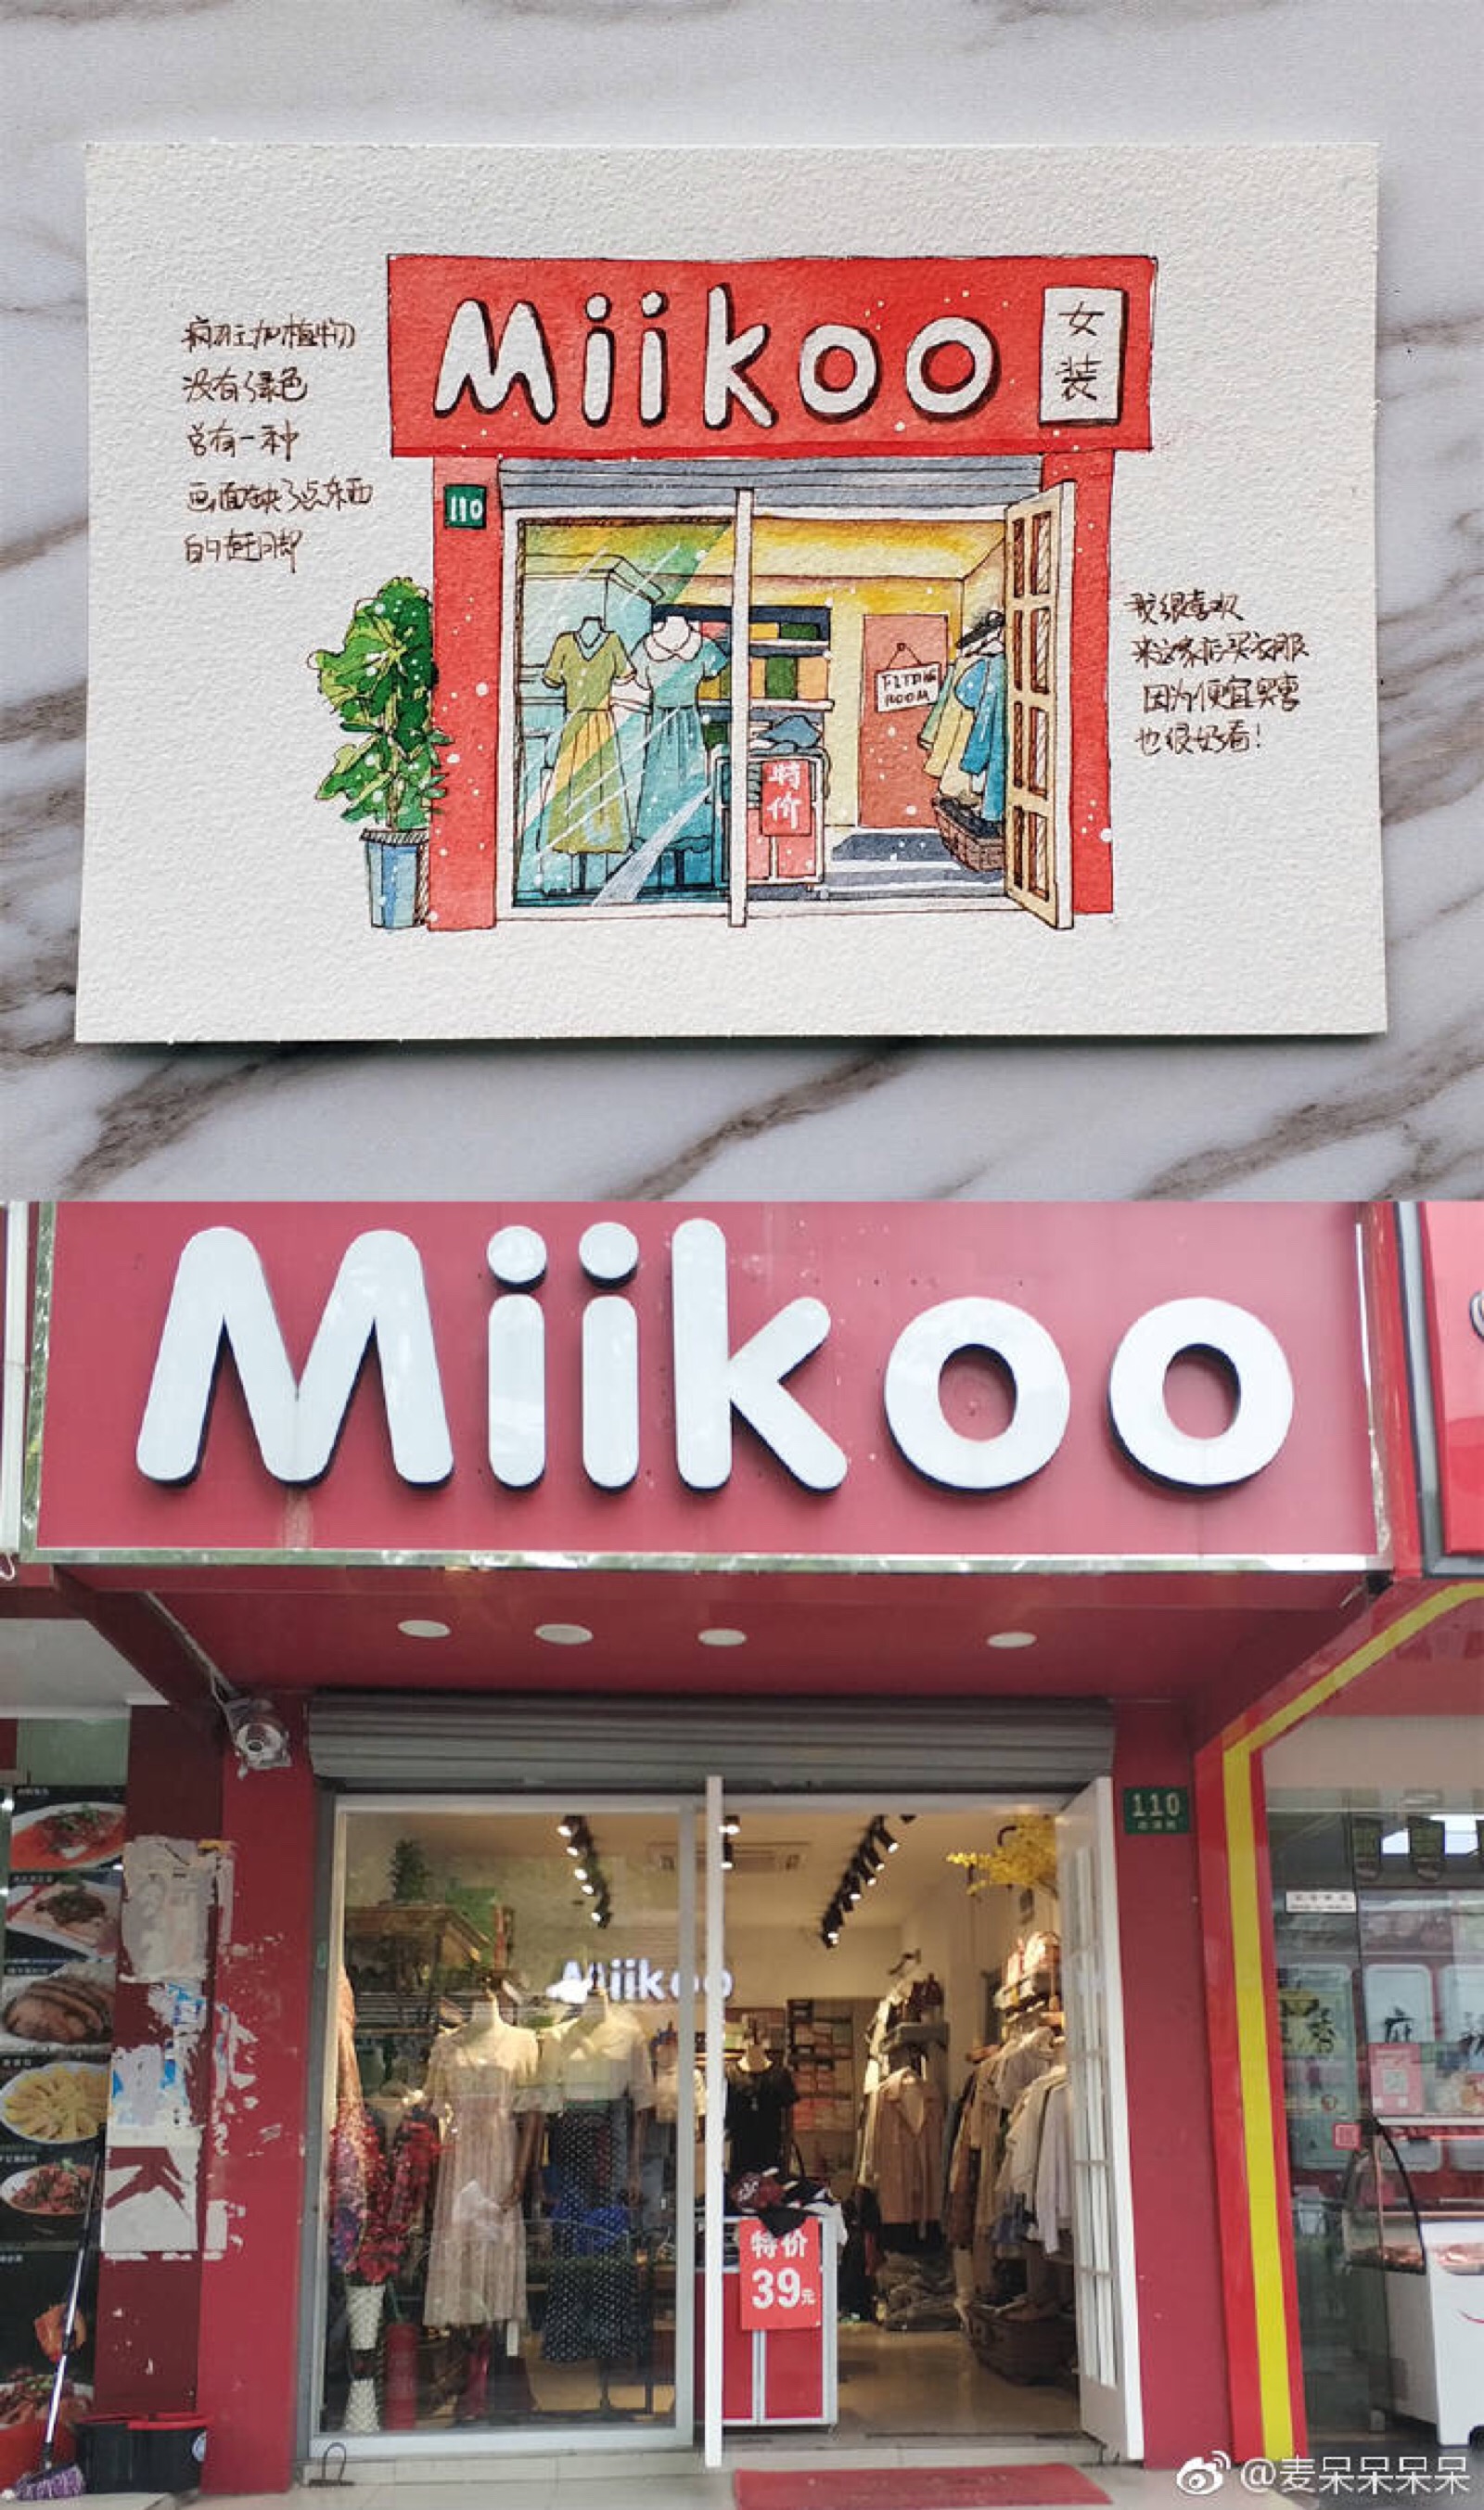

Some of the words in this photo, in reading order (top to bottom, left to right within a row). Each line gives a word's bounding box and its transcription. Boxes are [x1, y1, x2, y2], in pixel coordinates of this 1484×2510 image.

[433, 285, 996, 429] Miikoo
[1055, 301, 1105, 402] 女装
[183, 365, 308, 403] 没有绿色
[187, 419, 300, 462] 总有一种
[451, 494, 483, 521] 110
[135, 1218, 1295, 1491] Miikoo
[1132, 1792, 1181, 1817] 110
[750, 2229, 809, 2260] 特价
[751, 2267, 816, 2310] 39元
